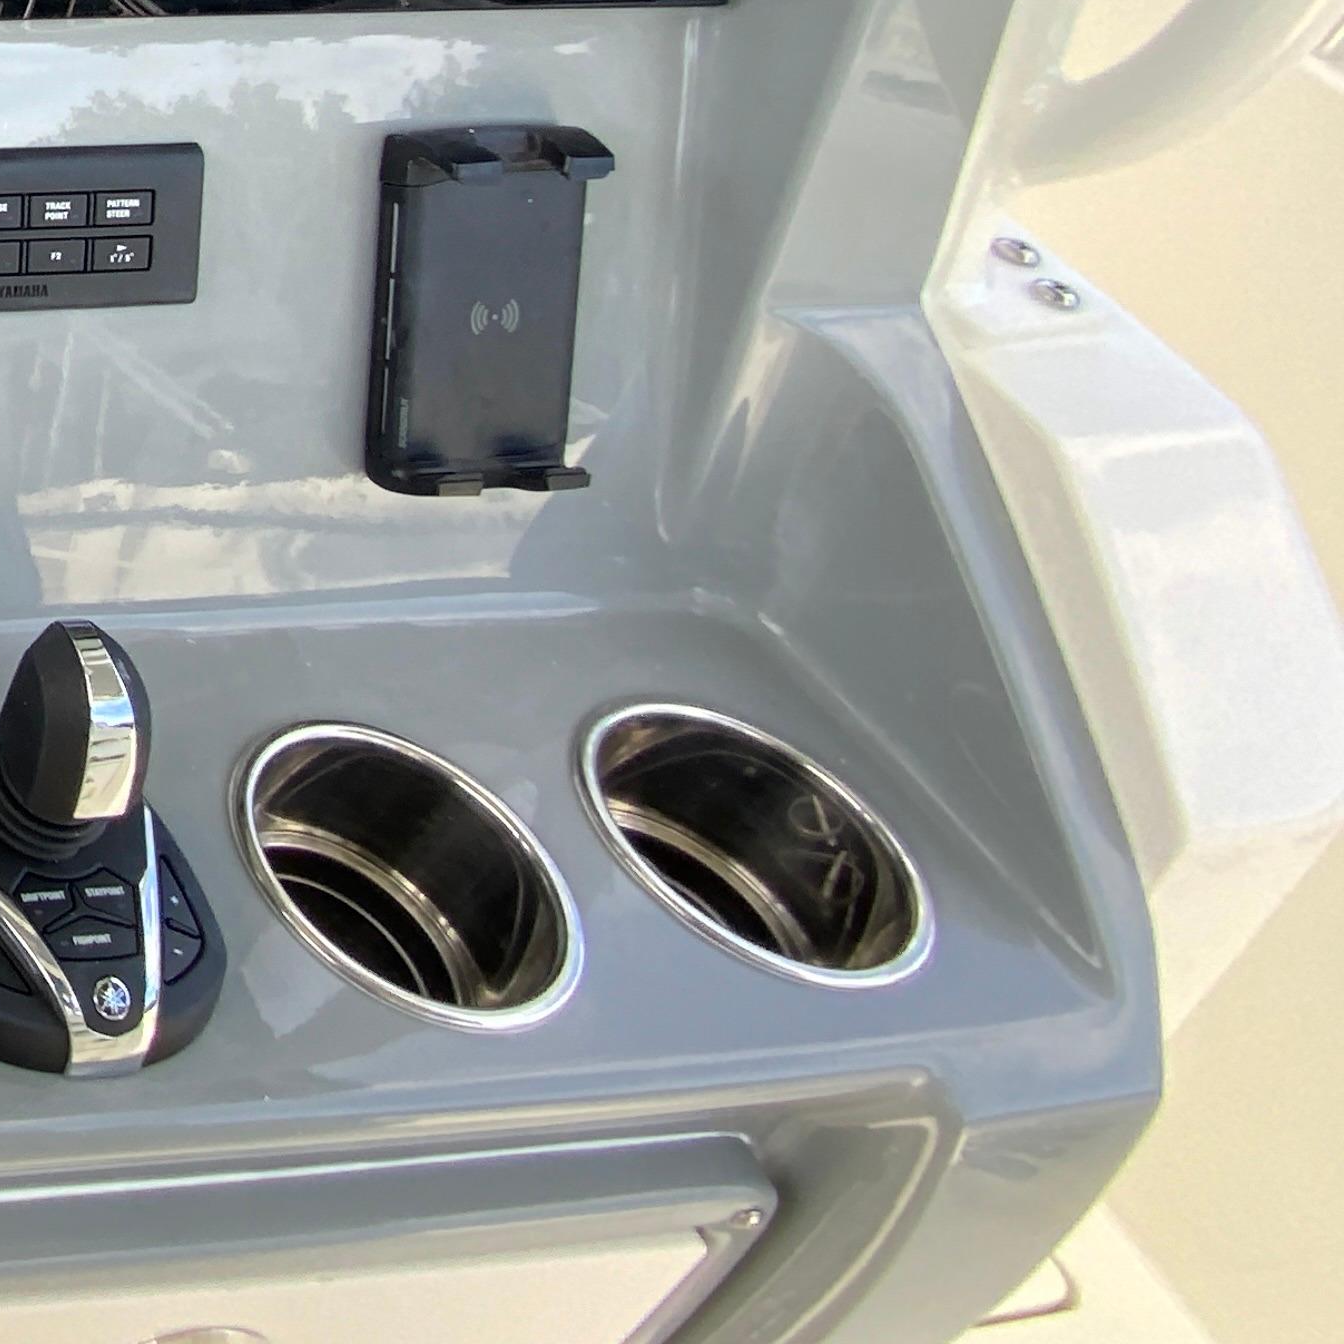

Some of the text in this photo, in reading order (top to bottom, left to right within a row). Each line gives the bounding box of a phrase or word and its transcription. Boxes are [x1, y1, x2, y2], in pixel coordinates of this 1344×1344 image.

[45, 201, 71, 210] TRACK
[106, 199, 140, 207] PATTERN
[45, 211, 68, 220] POINT
[106, 209, 130, 218] STEER
[51, 252, 62, 260] F2
[20, 890, 65, 902] DRIFTPOINT
[85, 886, 125, 897] STAYPOINT
